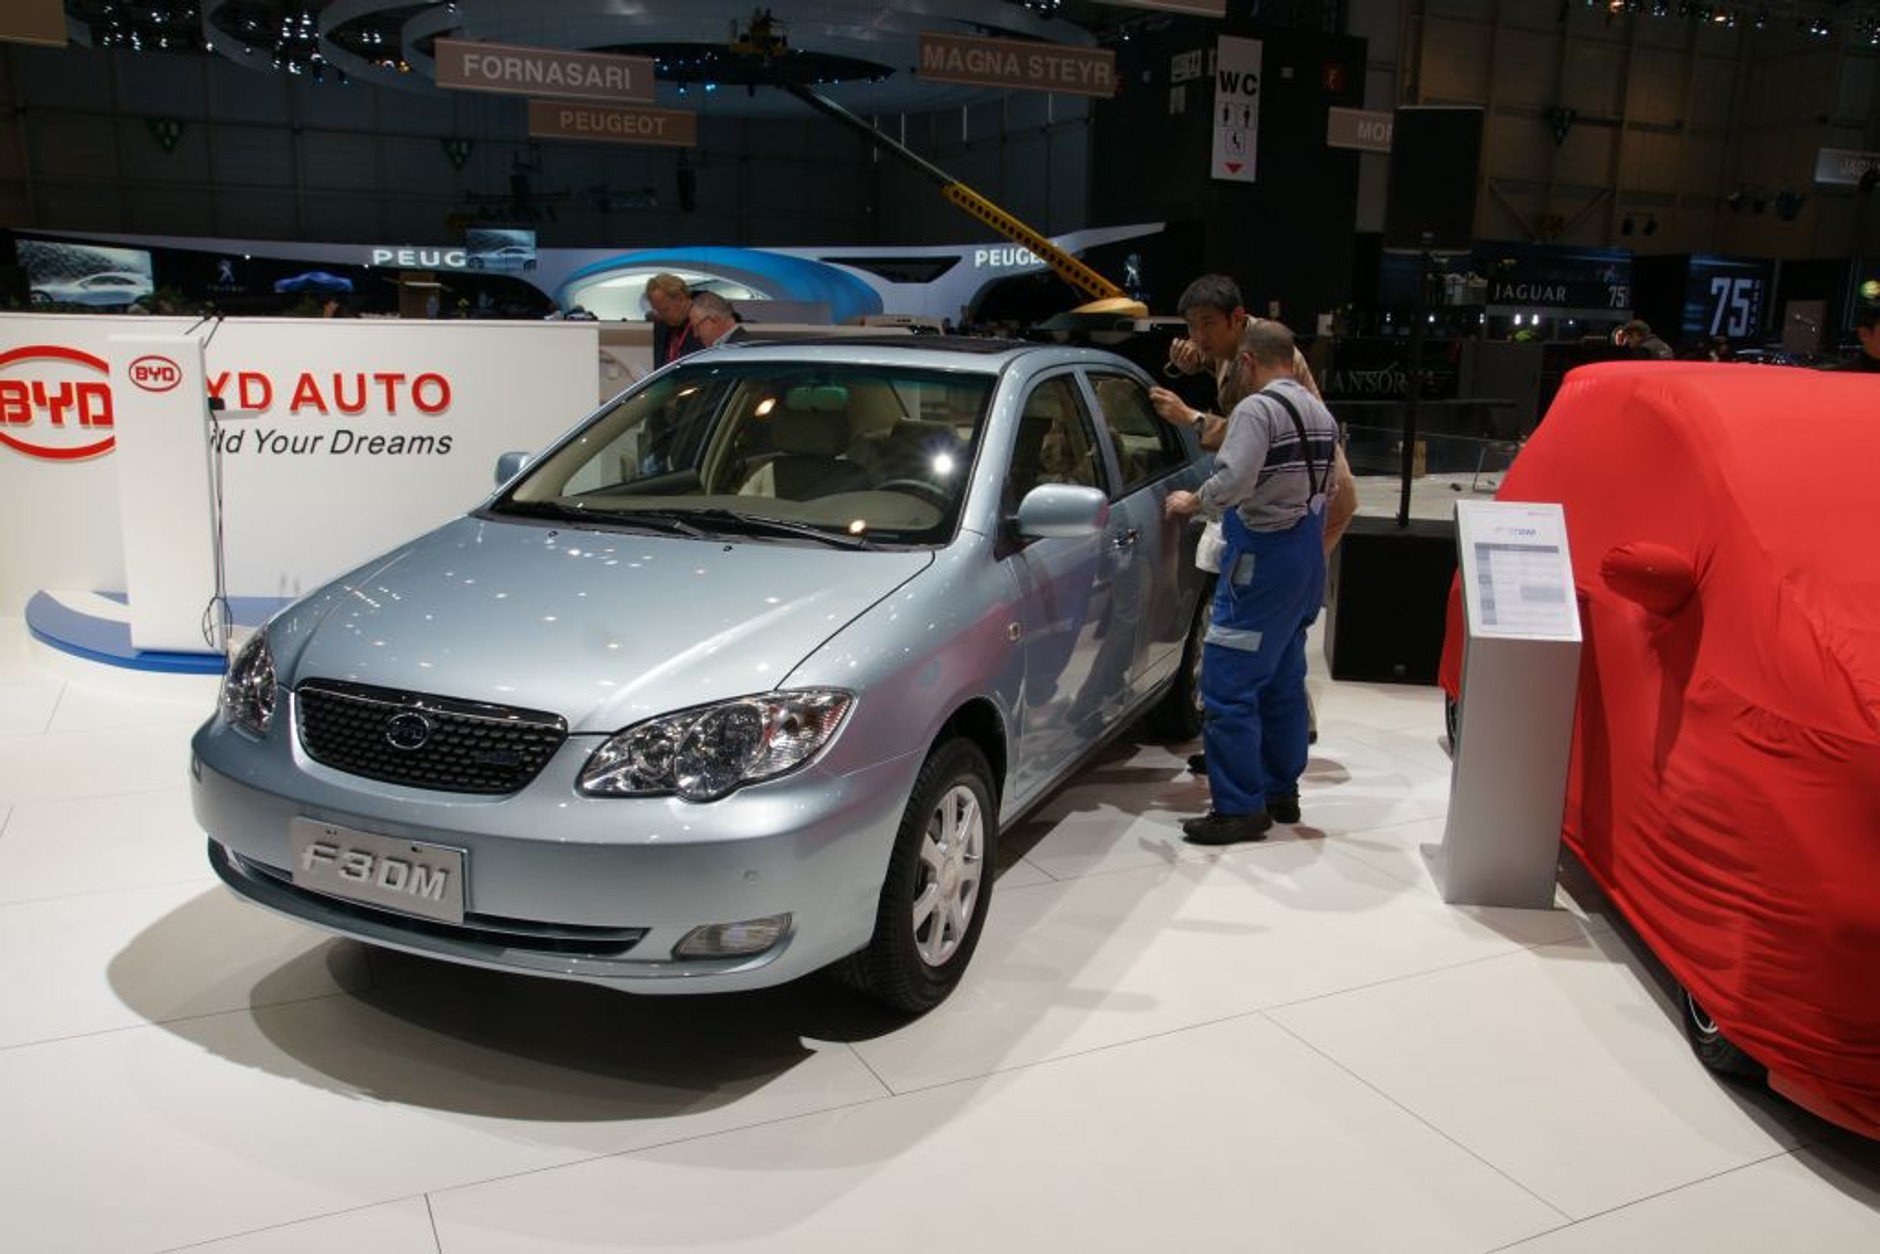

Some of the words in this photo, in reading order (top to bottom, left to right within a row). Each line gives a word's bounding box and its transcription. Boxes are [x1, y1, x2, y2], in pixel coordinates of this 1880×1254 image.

[462, 53, 631, 90] FORNASARI
[922, 43, 1022, 78] MAGNA
[1027, 54, 1111, 86] STEYR
[1219, 70, 1258, 96] WC
[559, 109, 669, 136] PEUGEOT
[373, 248, 467, 268] PEUG
[1493, 281, 1567, 302] JAGUAR
[1708, 276, 1754, 338] 75
[135, 366, 175, 382] BYD
[0, 379, 114, 427] BYD
[289, 372, 452, 414] AUTO
[255, 428, 325, 455] Your
[329, 429, 453, 455] Dreams
[301, 842, 448, 901] F3DM
